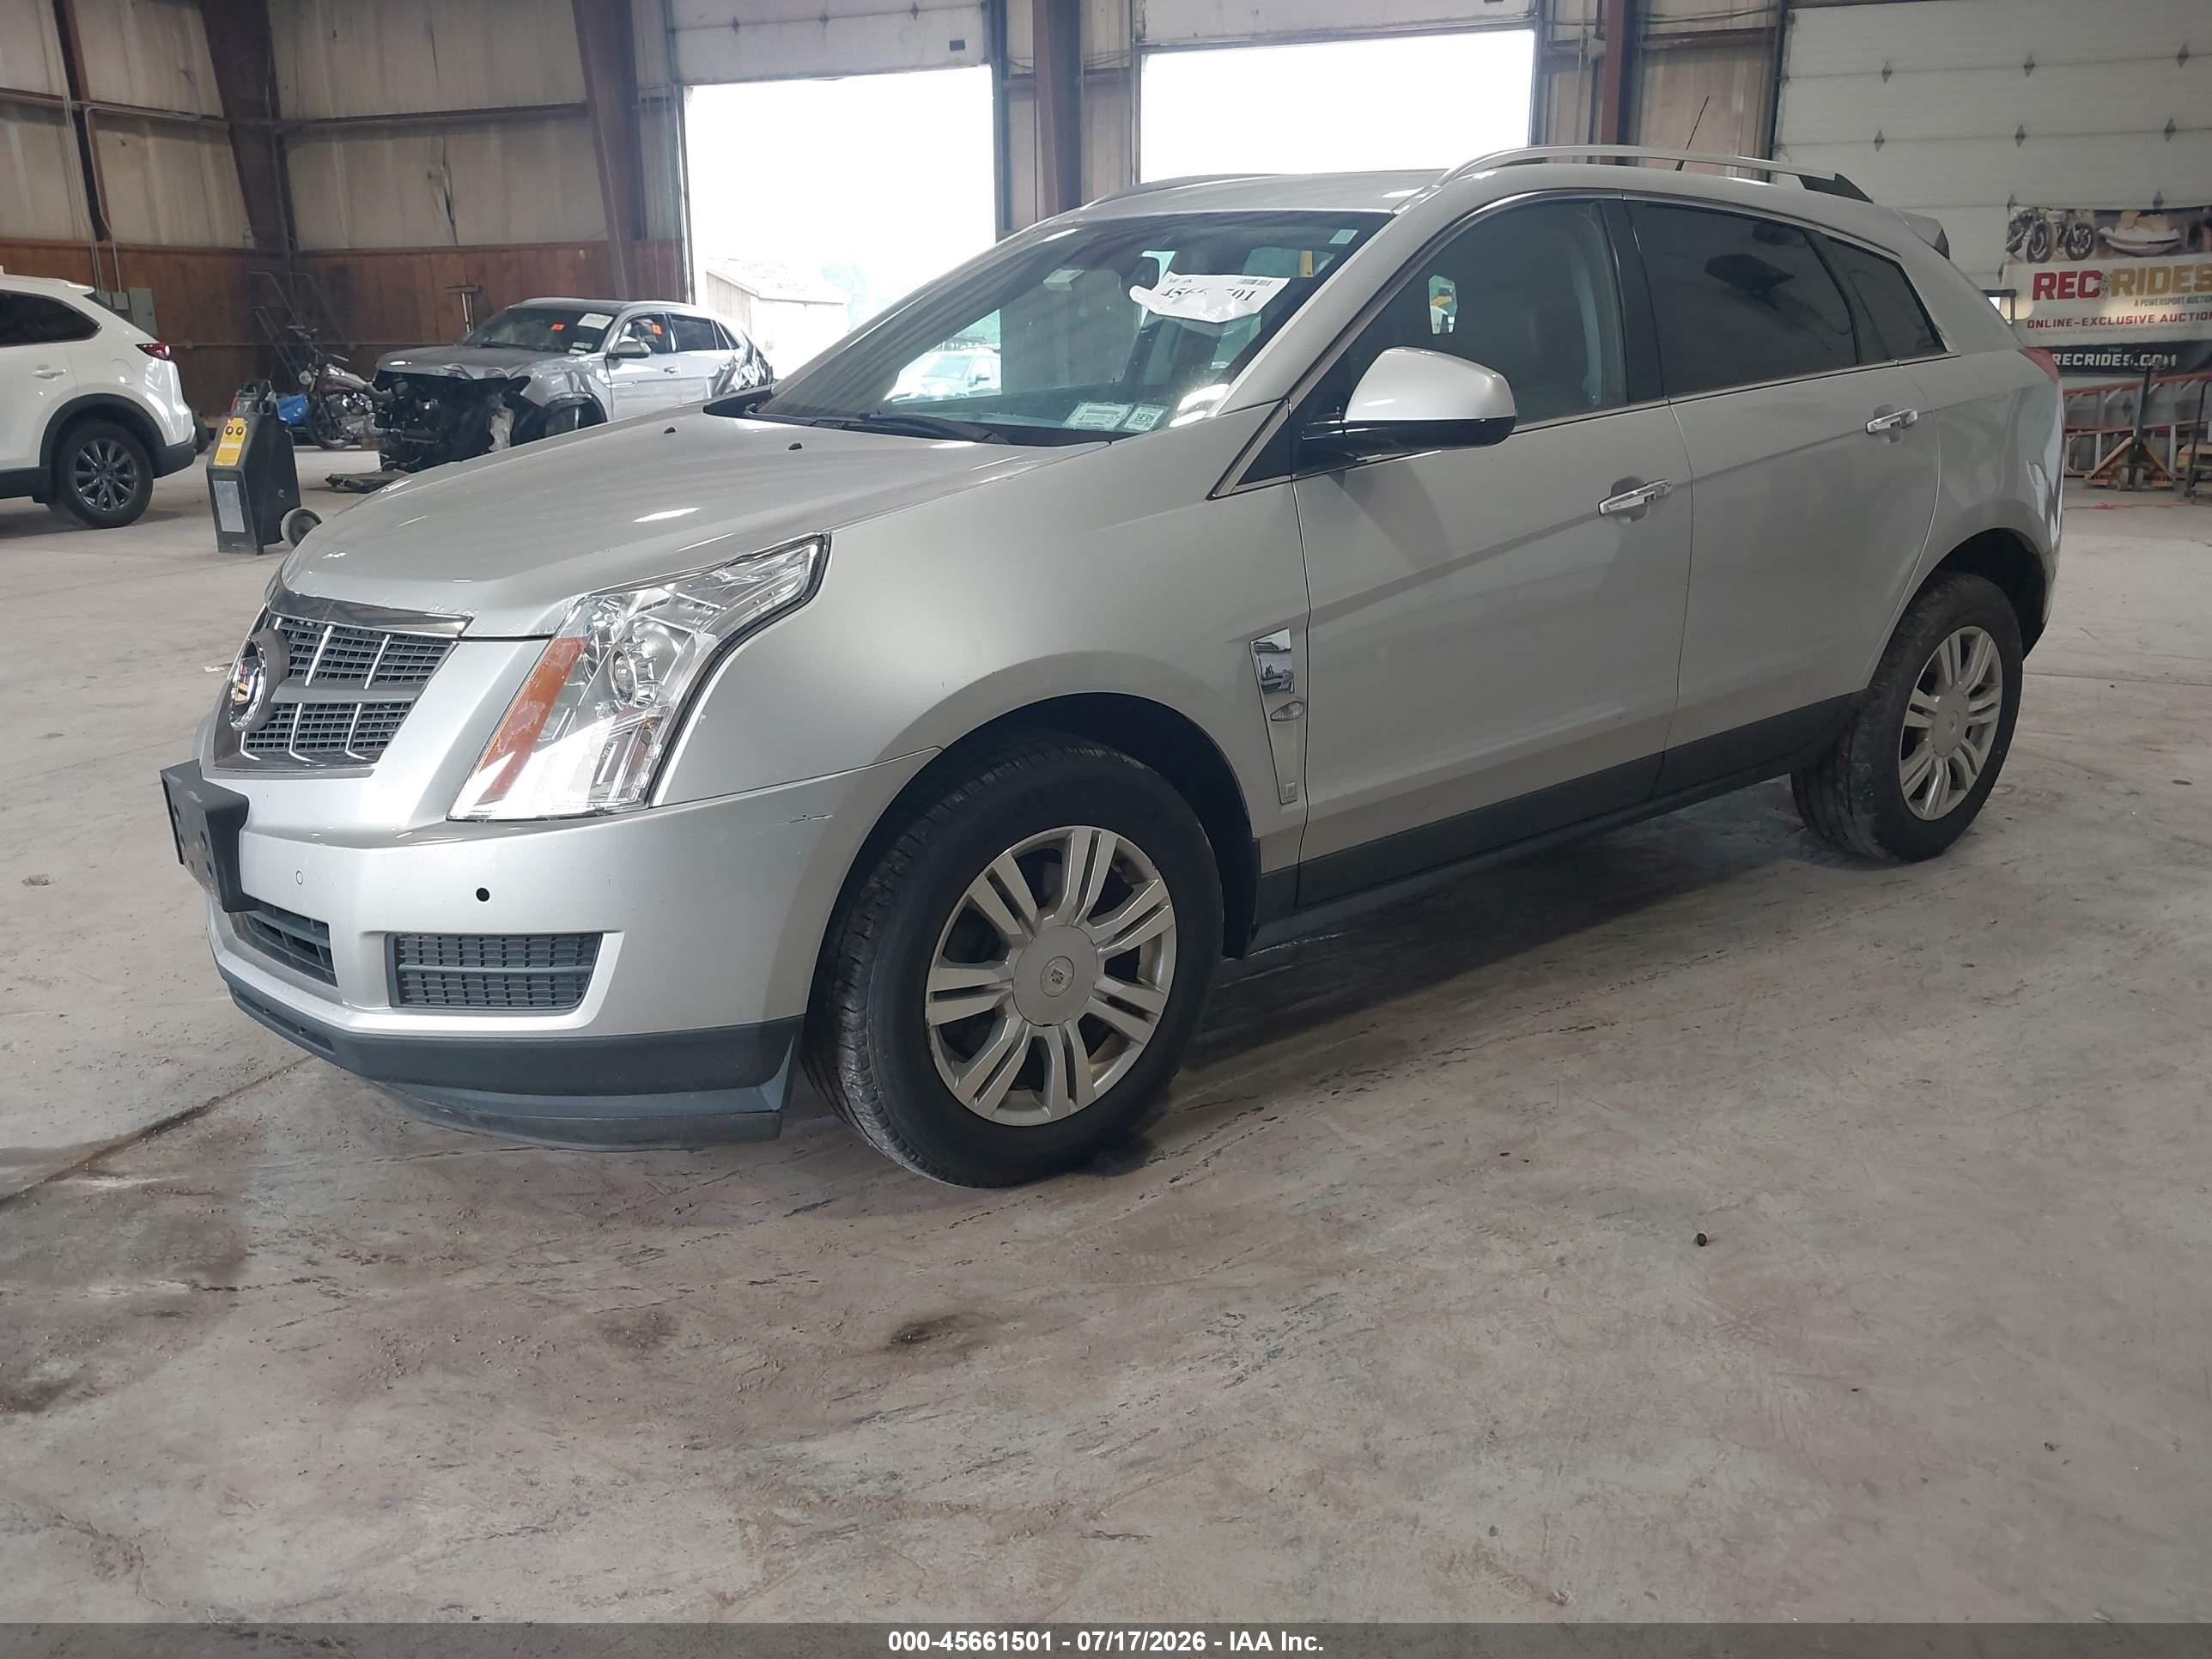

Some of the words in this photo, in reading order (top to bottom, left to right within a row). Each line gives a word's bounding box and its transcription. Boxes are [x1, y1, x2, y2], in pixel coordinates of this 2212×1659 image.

[2033, 270, 2103, 301] REC
[2111, 263, 2212, 297] RIDES
[2027, 313, 2154, 329] ONLINE-EXCLUSIVE
